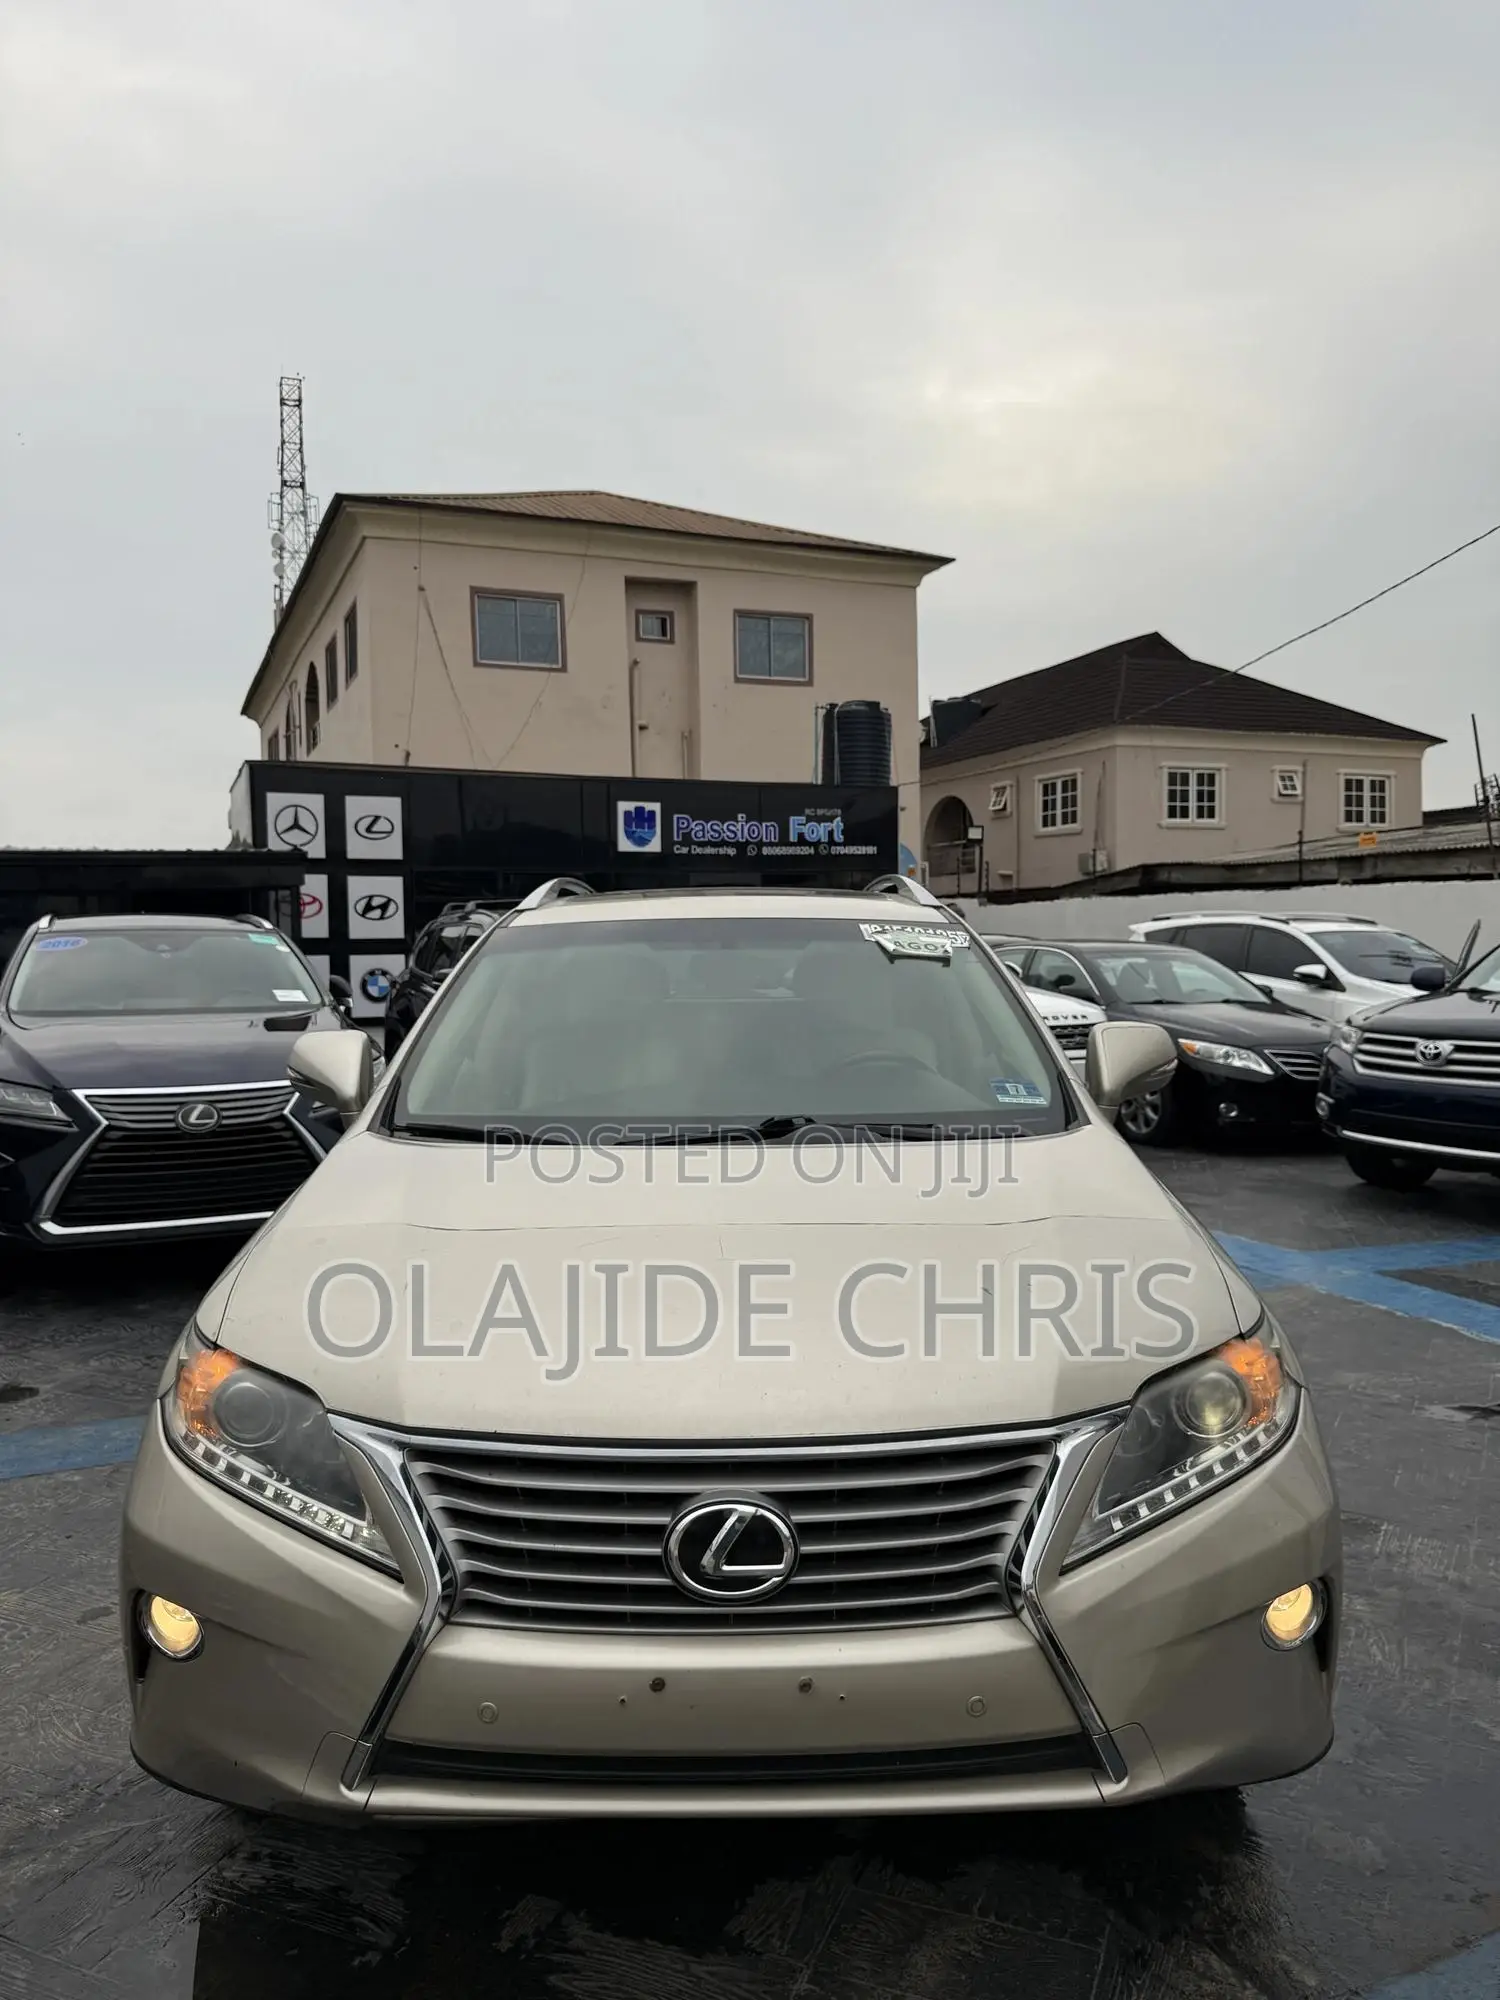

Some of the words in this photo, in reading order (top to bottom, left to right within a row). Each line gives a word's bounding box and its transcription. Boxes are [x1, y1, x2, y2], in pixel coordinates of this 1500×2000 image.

[673, 814, 778, 843] Passion
[789, 815, 844, 844] Fort
[674, 845, 690, 854] Car
[691, 845, 736, 857] Dealership
